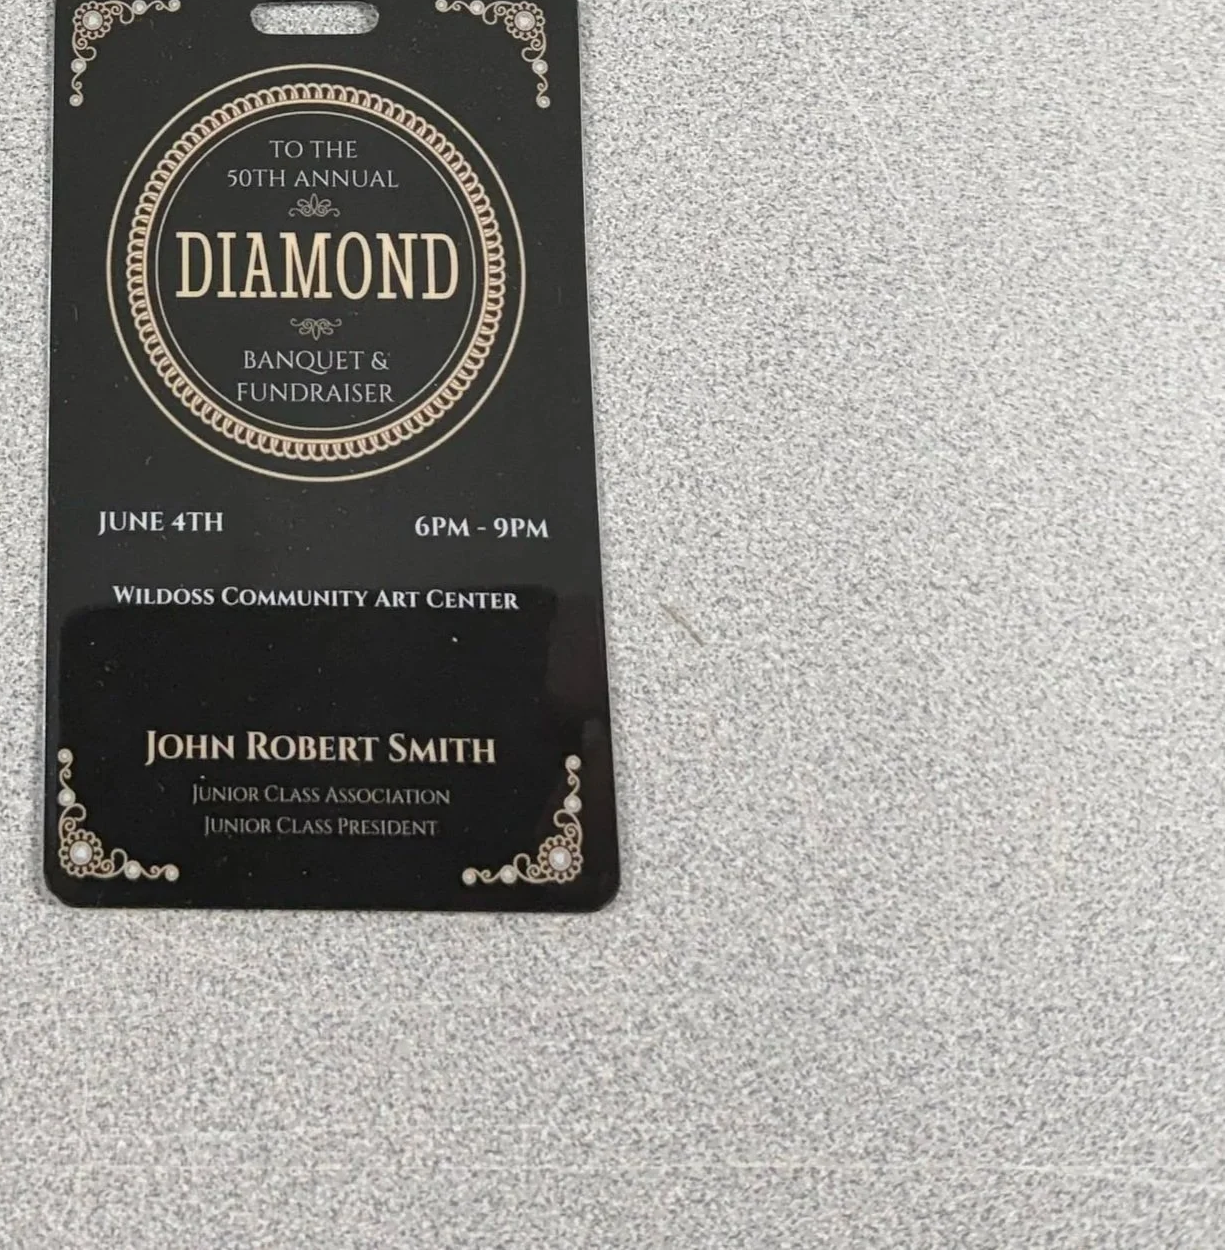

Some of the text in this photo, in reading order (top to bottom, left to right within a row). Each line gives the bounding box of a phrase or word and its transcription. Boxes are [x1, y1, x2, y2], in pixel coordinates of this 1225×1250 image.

[269, 140, 358, 159] TO THE
[227, 168, 399, 188] 50TH ANNUAL
[175, 231, 459, 300] DIAMOND
[244, 350, 389, 376] BANQUET &
[237, 382, 395, 403] FUNDRAISER
[98, 511, 223, 536] JUNE 4TH
[414, 515, 470, 537] 6PM
[493, 517, 549, 538] 9PM
